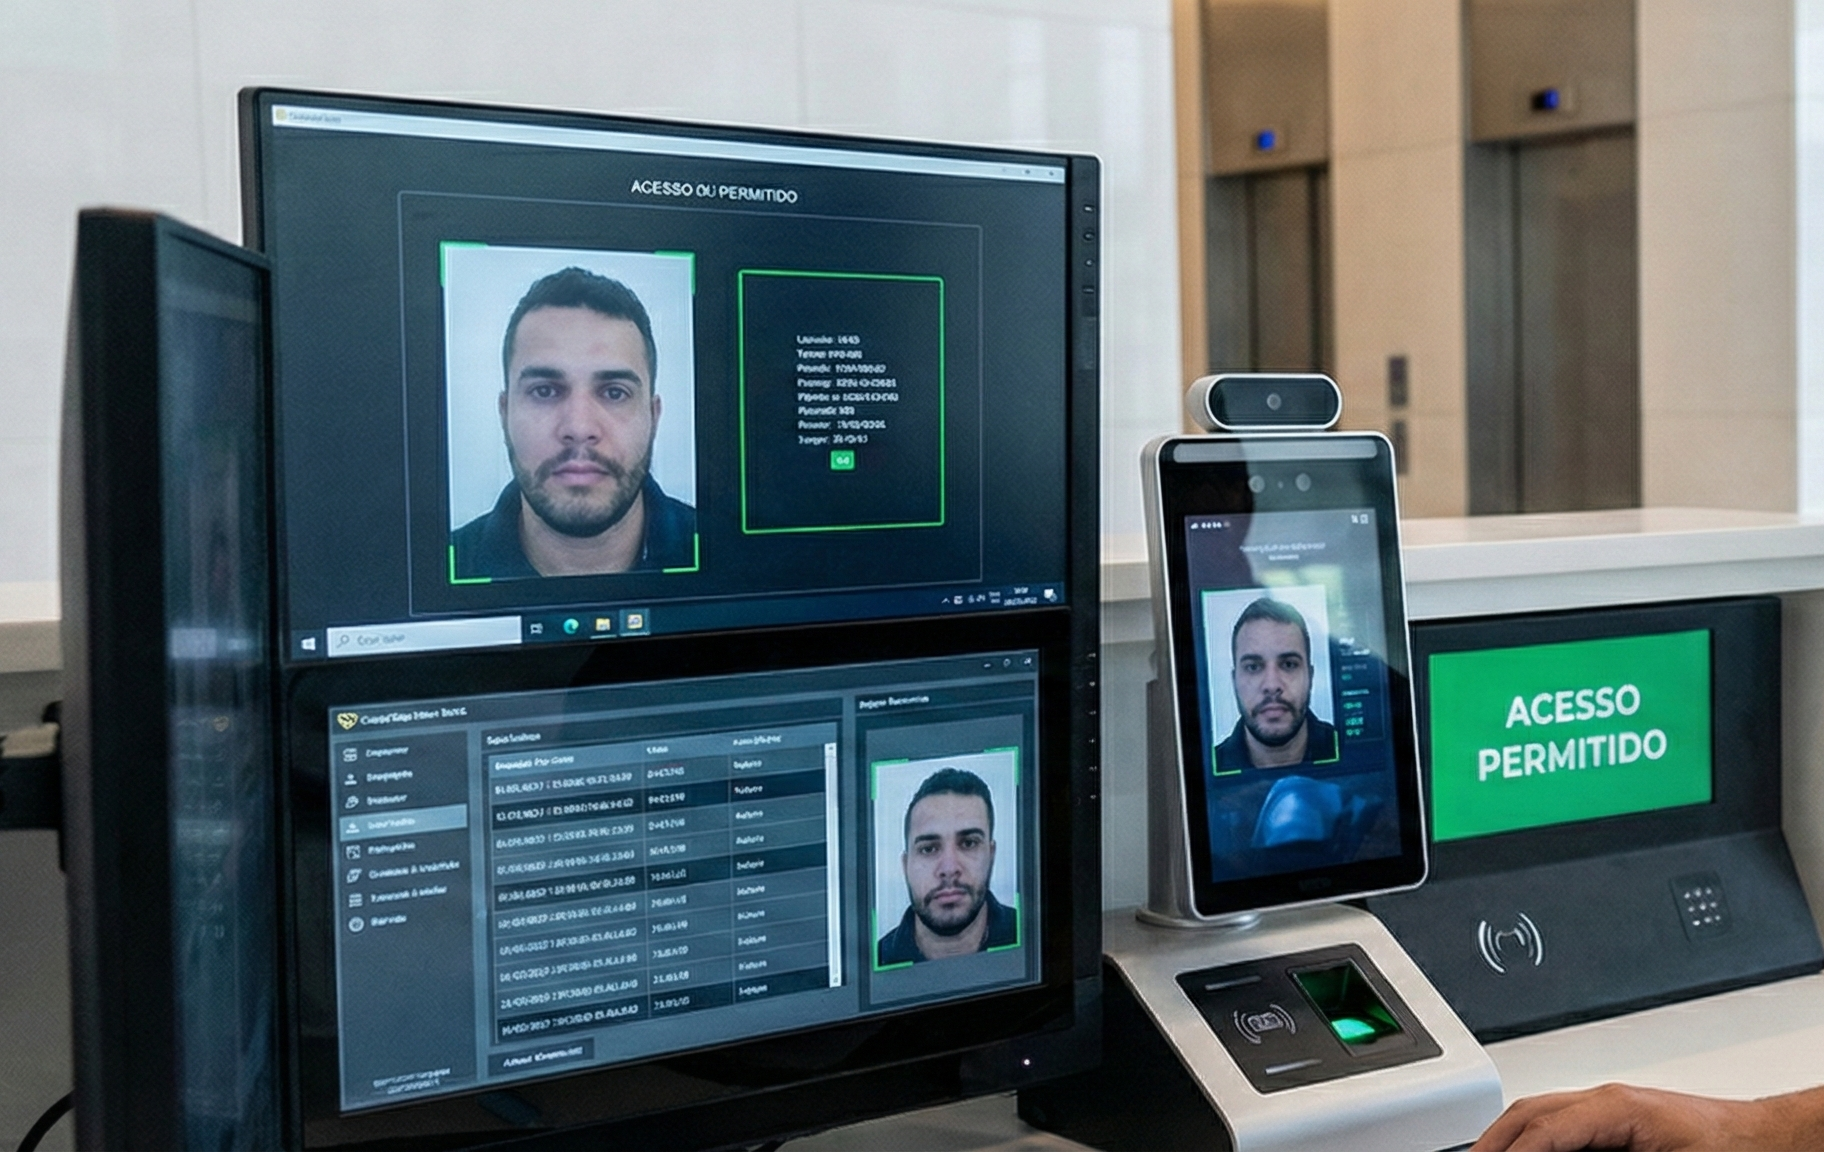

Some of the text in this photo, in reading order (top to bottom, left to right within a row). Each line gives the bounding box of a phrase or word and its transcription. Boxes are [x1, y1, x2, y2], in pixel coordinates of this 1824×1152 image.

[630, 179, 694, 197] ACESSO
[718, 185, 799, 204] PERMITIDO
[1505, 683, 1641, 729] ACESSO
[1478, 728, 1668, 782] PERMITIDO
